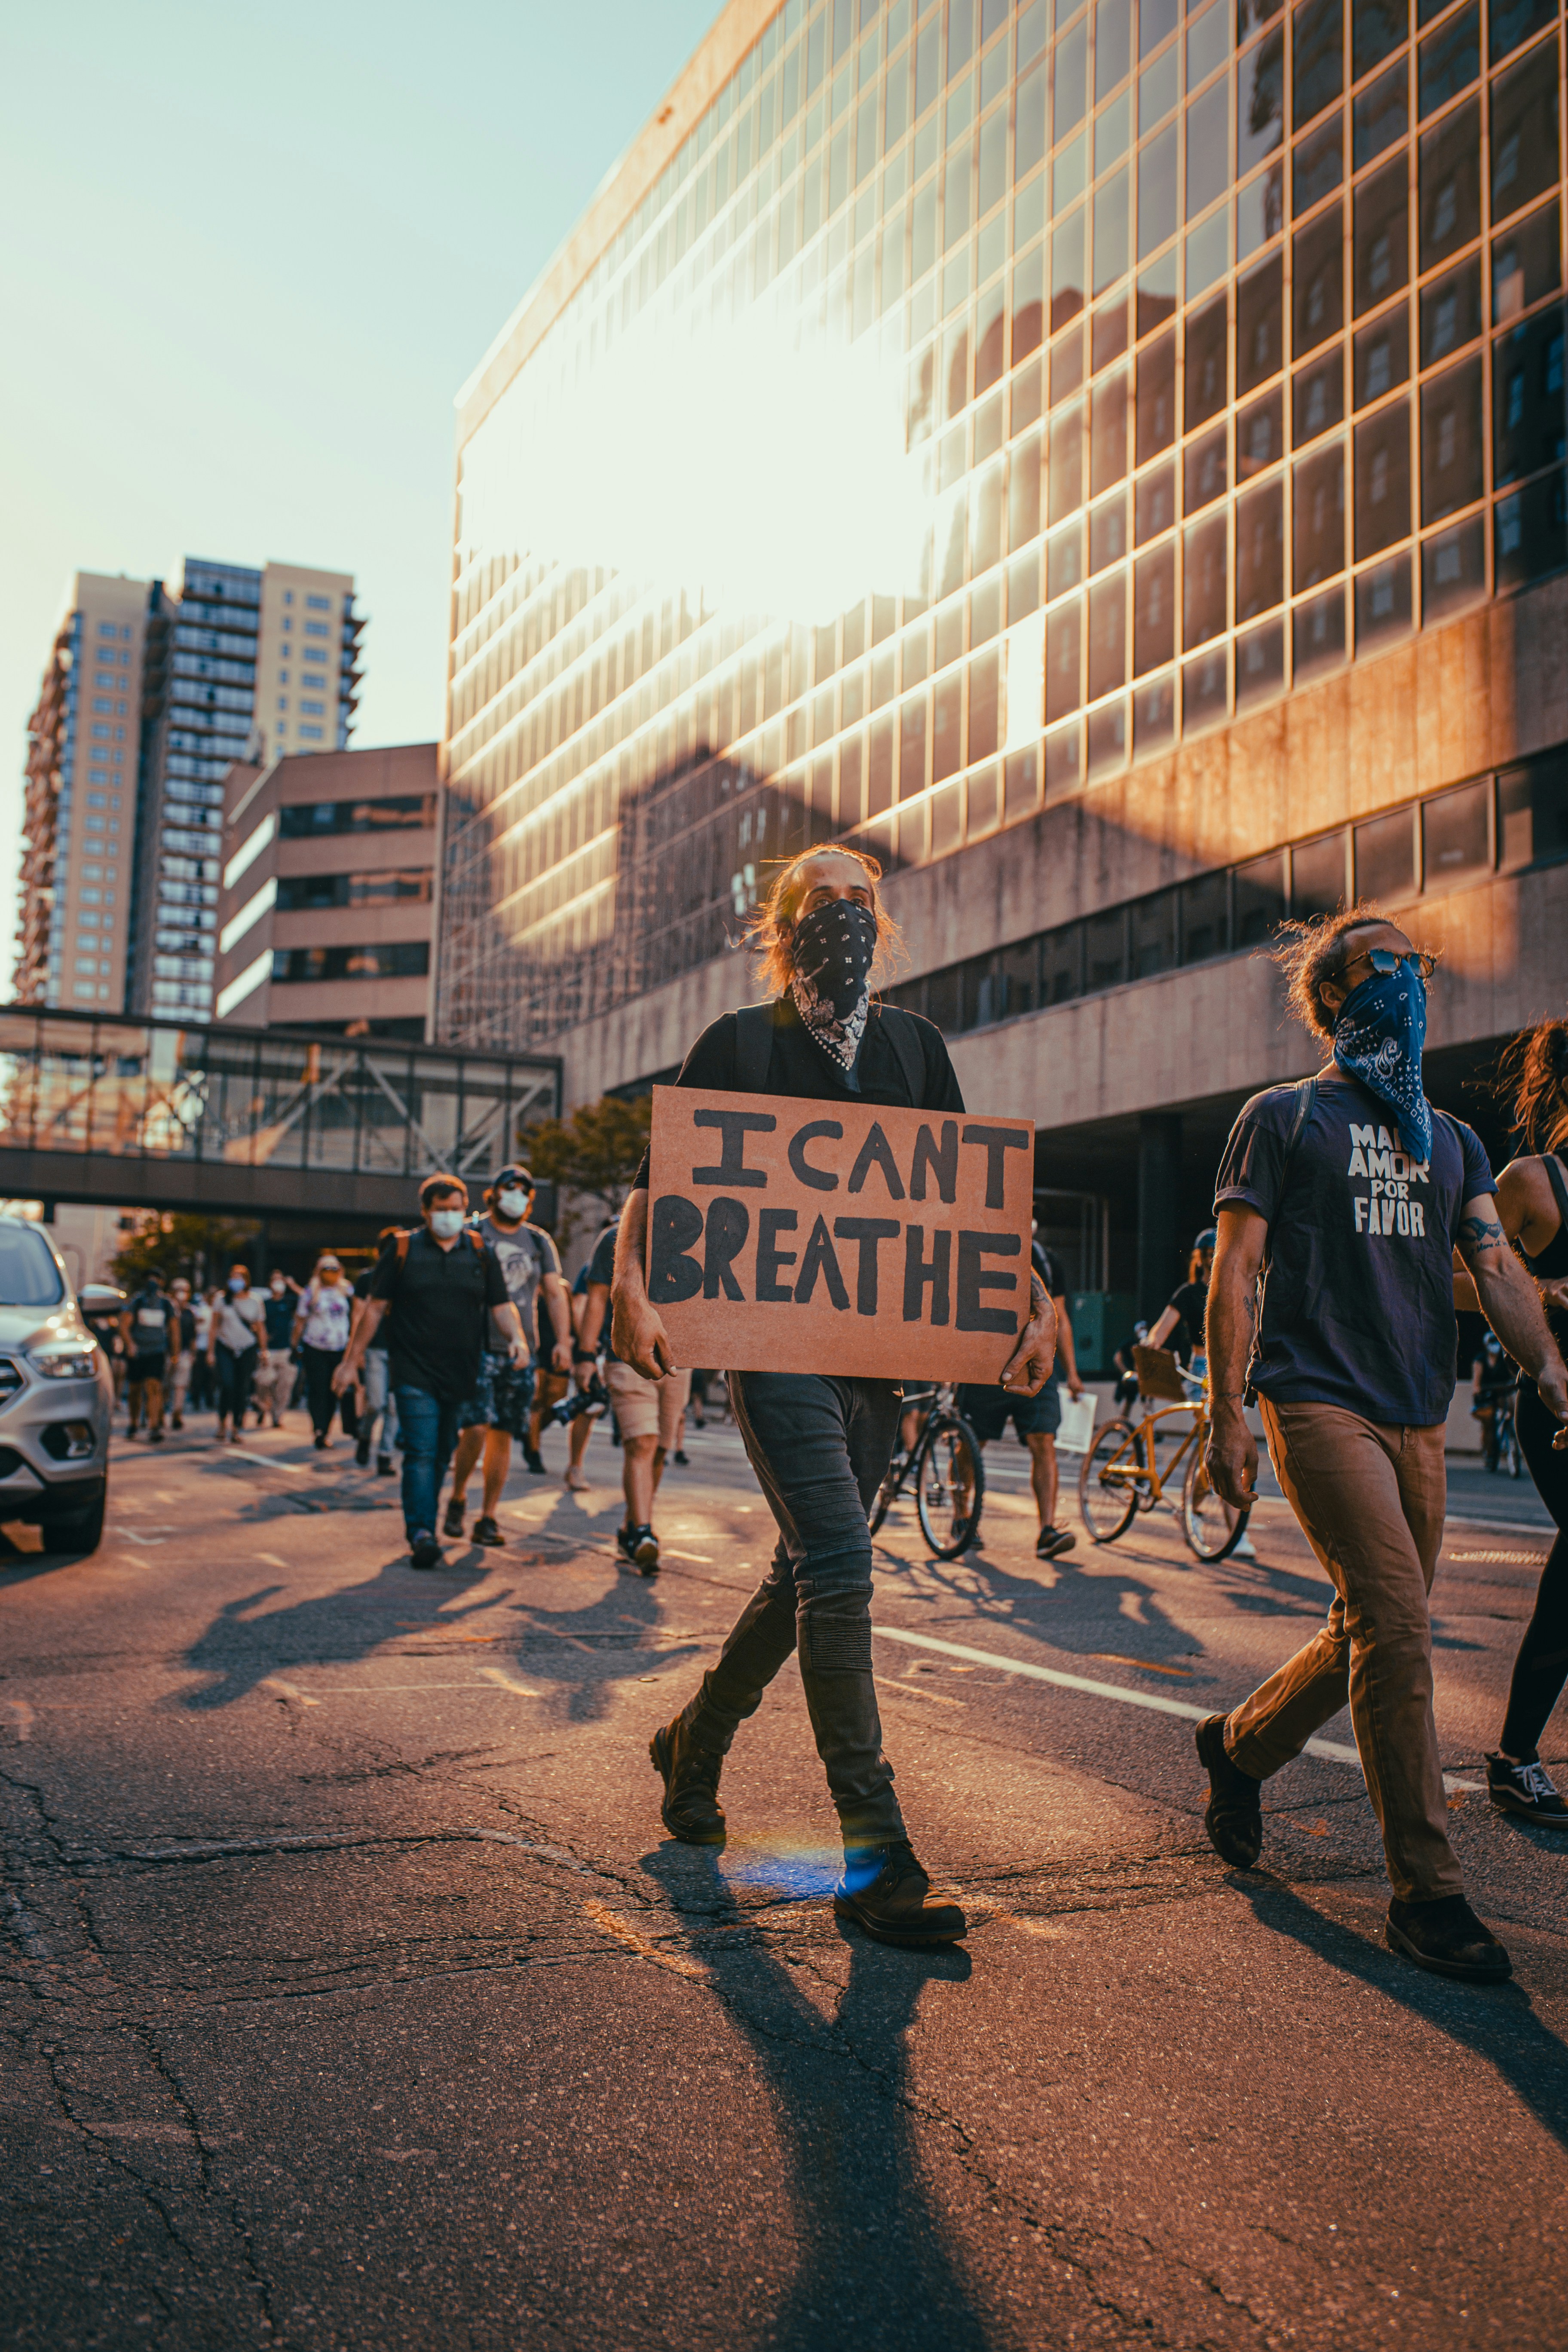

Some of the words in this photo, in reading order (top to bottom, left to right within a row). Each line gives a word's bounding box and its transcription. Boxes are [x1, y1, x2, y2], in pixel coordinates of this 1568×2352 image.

[692, 1109, 776, 1188] I
[788, 1120, 1029, 1209] CANT
[1348, 1147, 1430, 1183] AMOR
[1371, 1179, 1409, 1200] POR
[1354, 1197, 1425, 1237] FAVOR
[648, 1194, 1021, 1335] BREATHE
